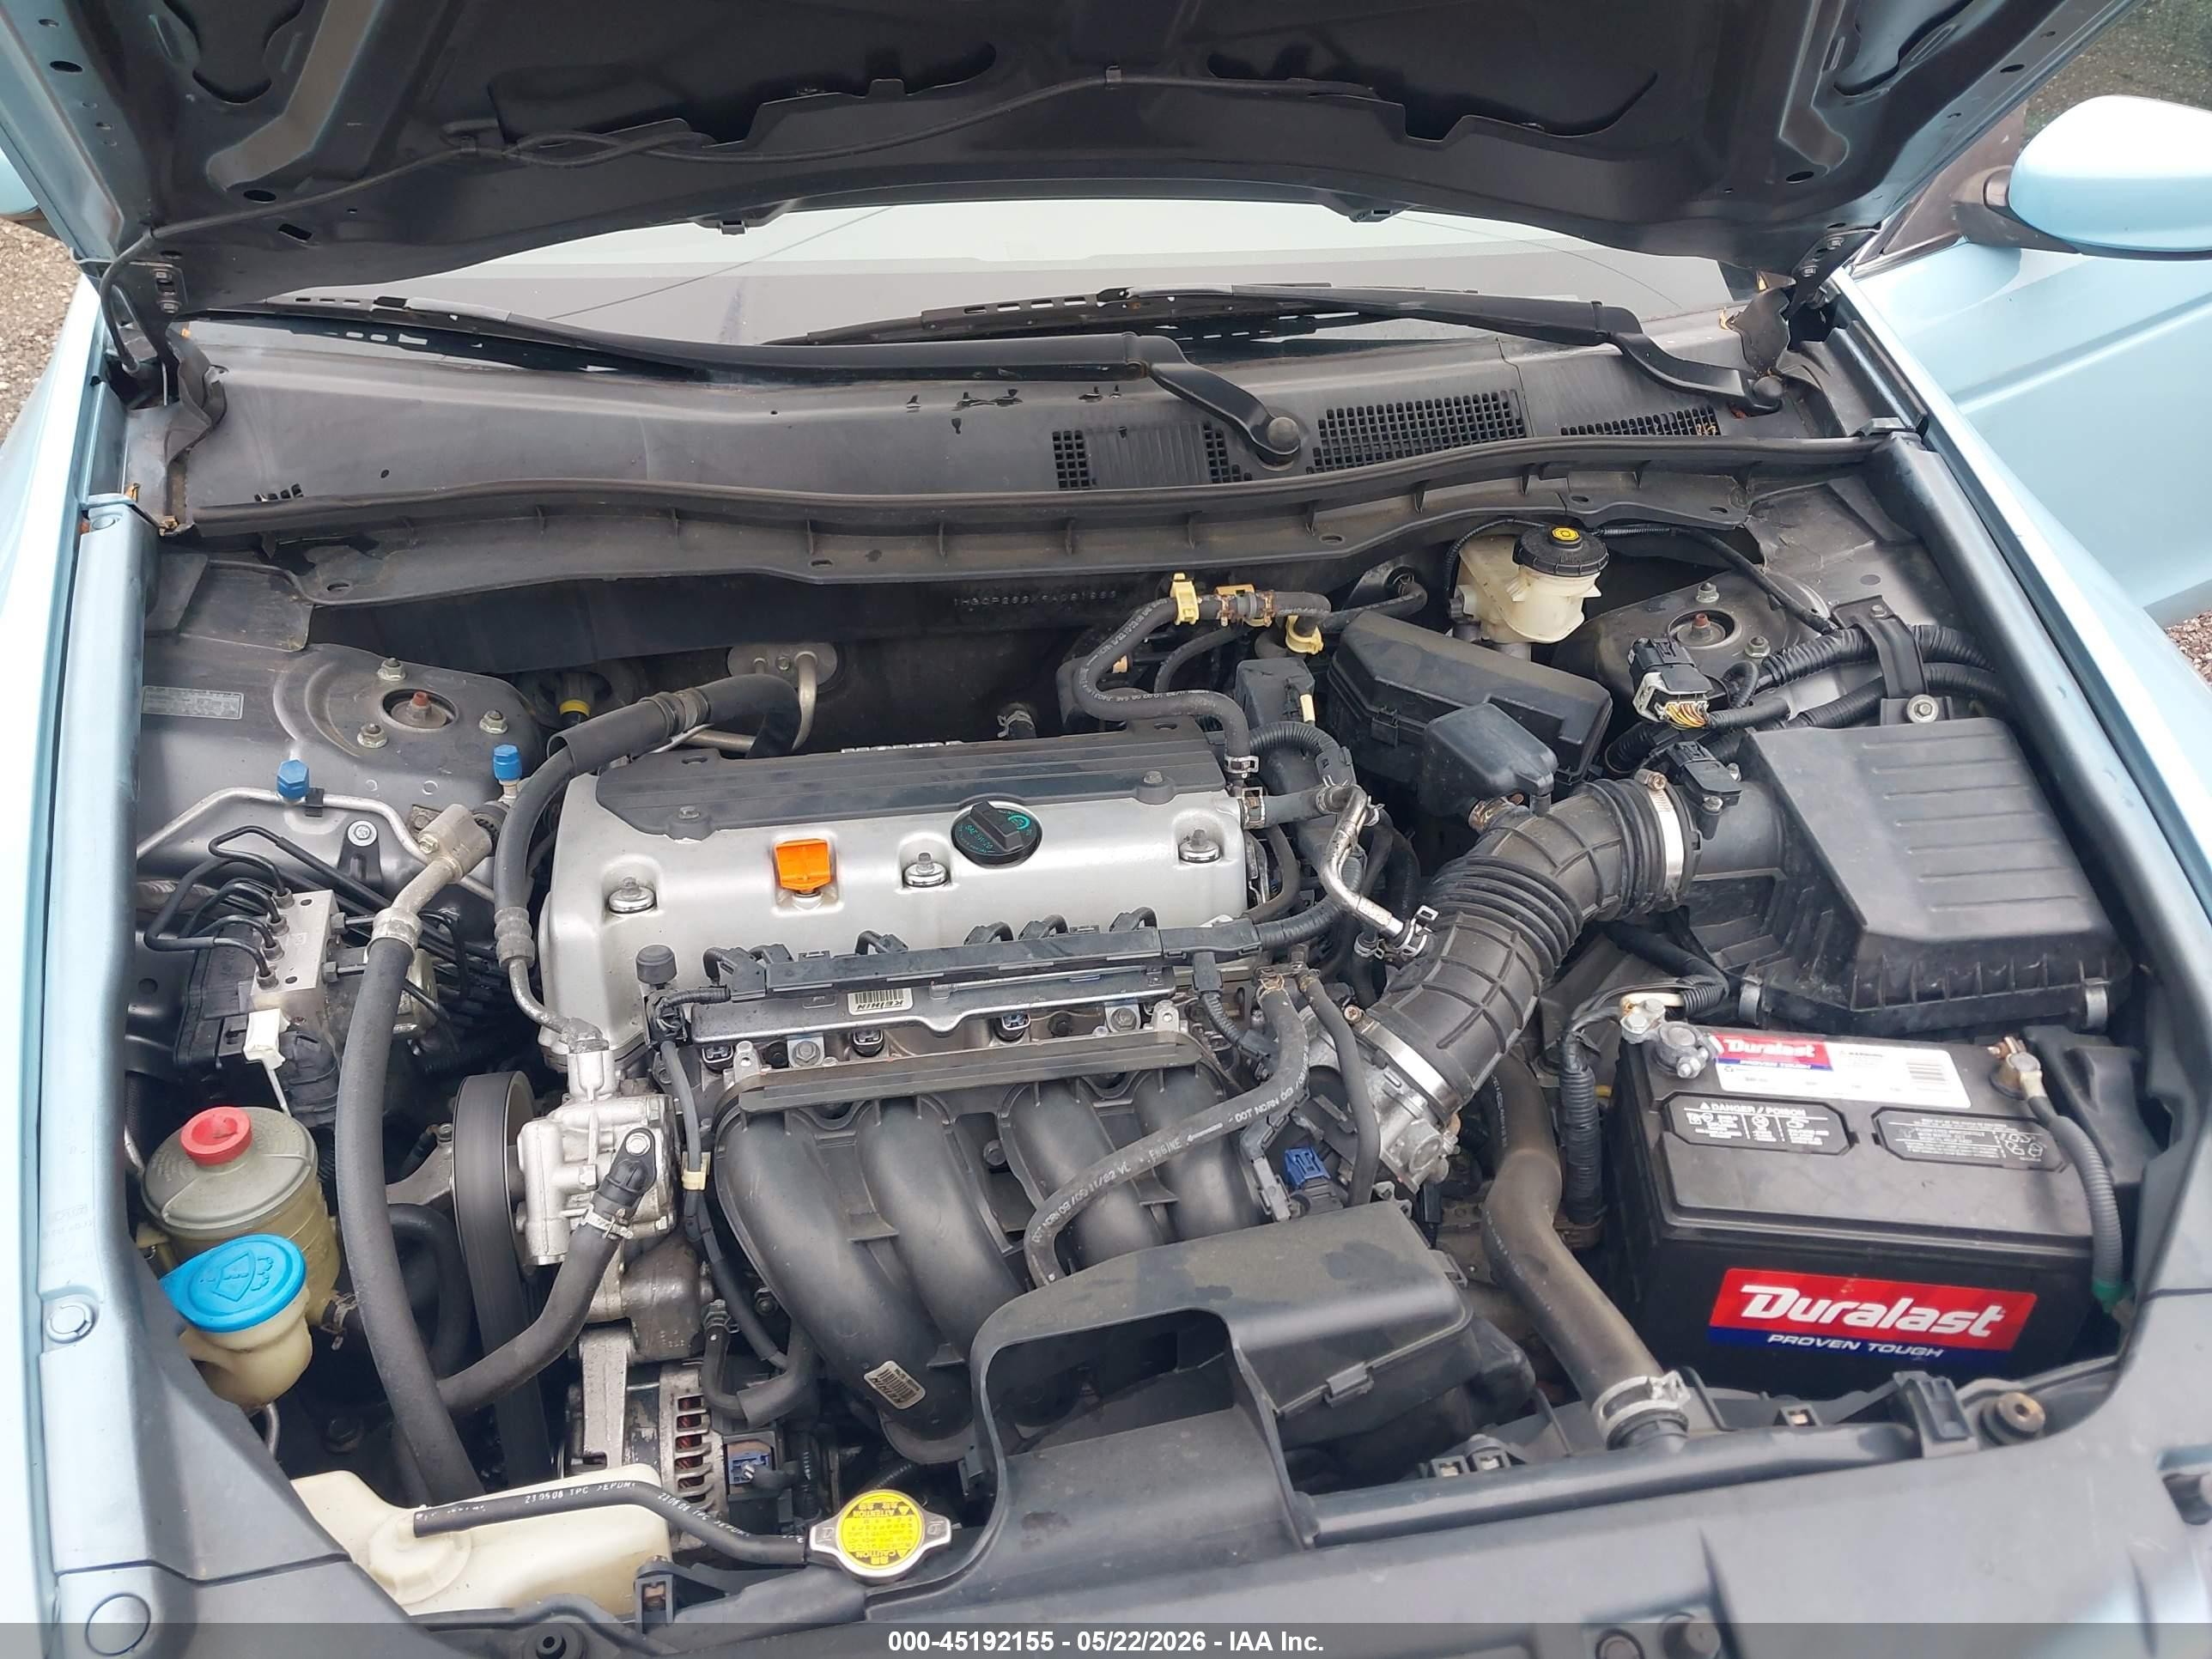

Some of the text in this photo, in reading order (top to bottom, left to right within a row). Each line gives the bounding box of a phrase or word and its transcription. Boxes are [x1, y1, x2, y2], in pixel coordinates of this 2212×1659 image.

[856, 1000, 904, 1012] KEIHIN
[1711, 1103, 1756, 1114] DANGER
[1765, 1106, 1807, 1116] POISON
[1741, 1285, 2005, 1337] Duralast
[1766, 1334, 1945, 1358] PROVEN TOUGH
